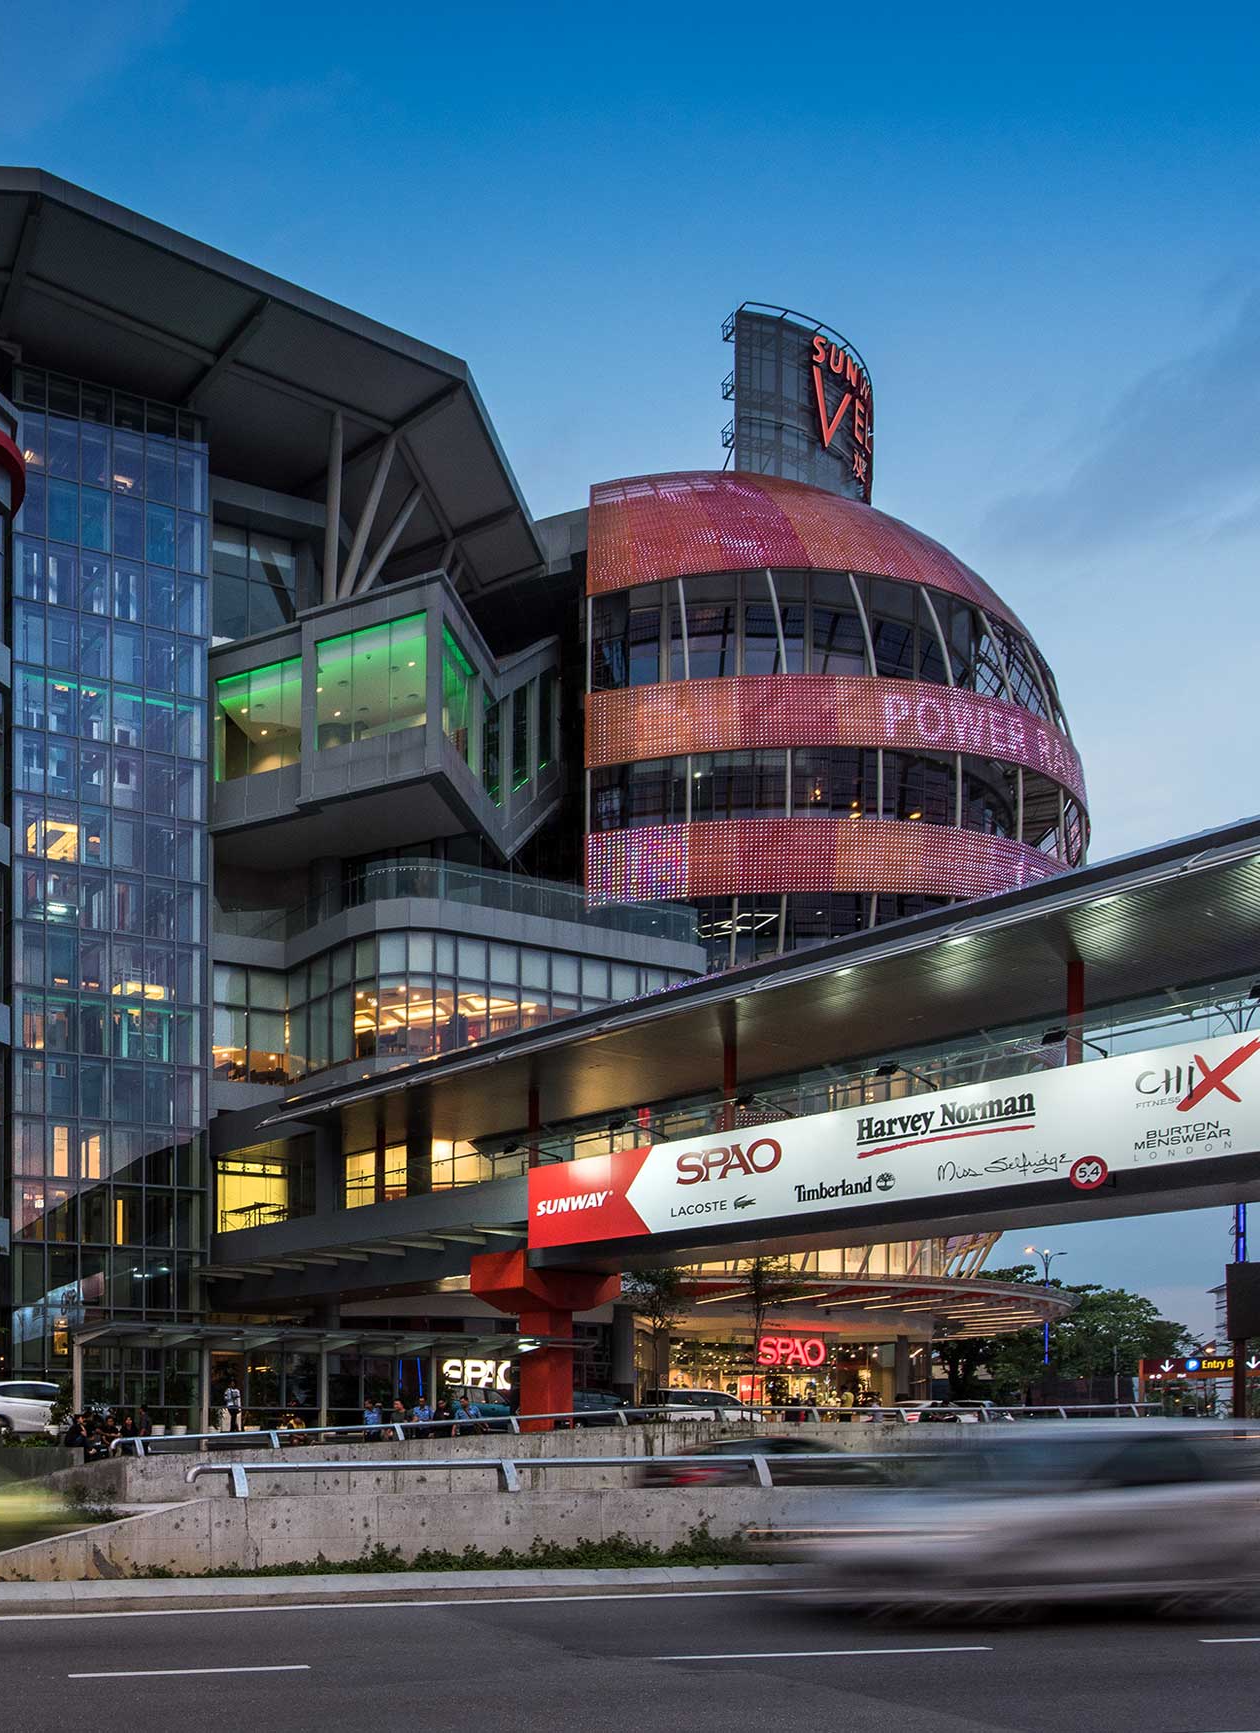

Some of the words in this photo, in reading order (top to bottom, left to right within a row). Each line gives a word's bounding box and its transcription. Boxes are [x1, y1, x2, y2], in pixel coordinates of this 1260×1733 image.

[883, 695, 1029, 759] POWER
[1136, 1096, 1181, 1109] FITNESS
[856, 1110, 935, 1142] Harvey
[940, 1092, 1036, 1127] Norman
[1134, 1128, 1231, 1150] MENSWEAR
[1146, 1120, 1220, 1140] BURTON
[676, 1138, 781, 1186] SPAO
[1134, 1141, 1232, 1161] LONDON
[937, 1161, 984, 1182] Miss
[984, 1150, 1073, 1176] Selfridge
[1078, 1166, 1100, 1179] 5.4
[794, 1174, 873, 1203] Timberland
[536, 1190, 610, 1216] SUNWAY
[670, 1200, 728, 1218] LACOSTE
[758, 1337, 827, 1367] SPAO
[1201, 1360, 1225, 1370] Entry
